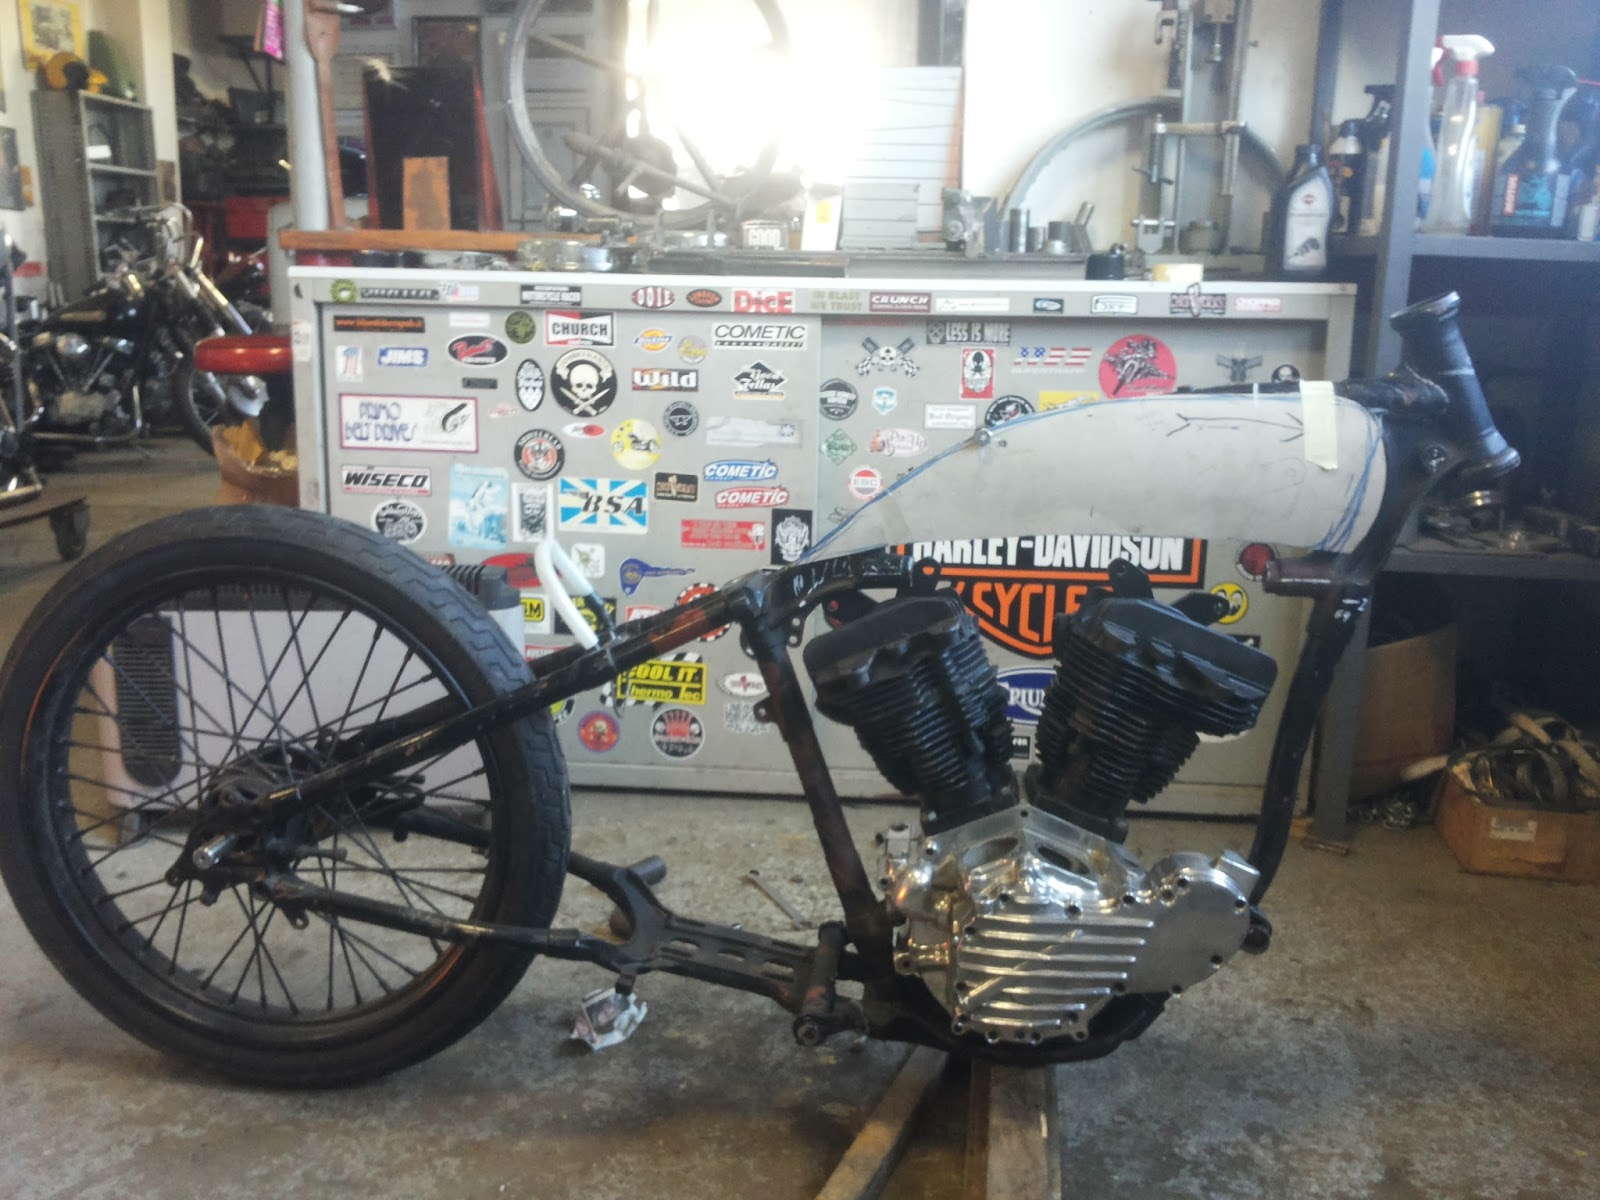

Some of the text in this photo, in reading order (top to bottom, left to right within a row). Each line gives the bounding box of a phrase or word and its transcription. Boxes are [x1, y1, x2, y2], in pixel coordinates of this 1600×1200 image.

[871, 295, 929, 305] CRUNCH
[552, 322, 608, 336] CHURCH
[715, 324, 805, 340] COMETIC
[946, 320, 969, 342] LESS
[971, 320, 982, 342] IS
[380, 349, 425, 366] JIMS
[633, 370, 698, 388] Wild
[704, 462, 777, 478] COMETIC
[344, 472, 429, 487] WISECO
[716, 488, 788, 504] COMETIC
[582, 495, 643, 514] BSA
[912, 534, 1186, 572] HARLEY-DAVIDSON
[677, 667, 698, 683] IT
[630, 684, 674, 700] hermo
